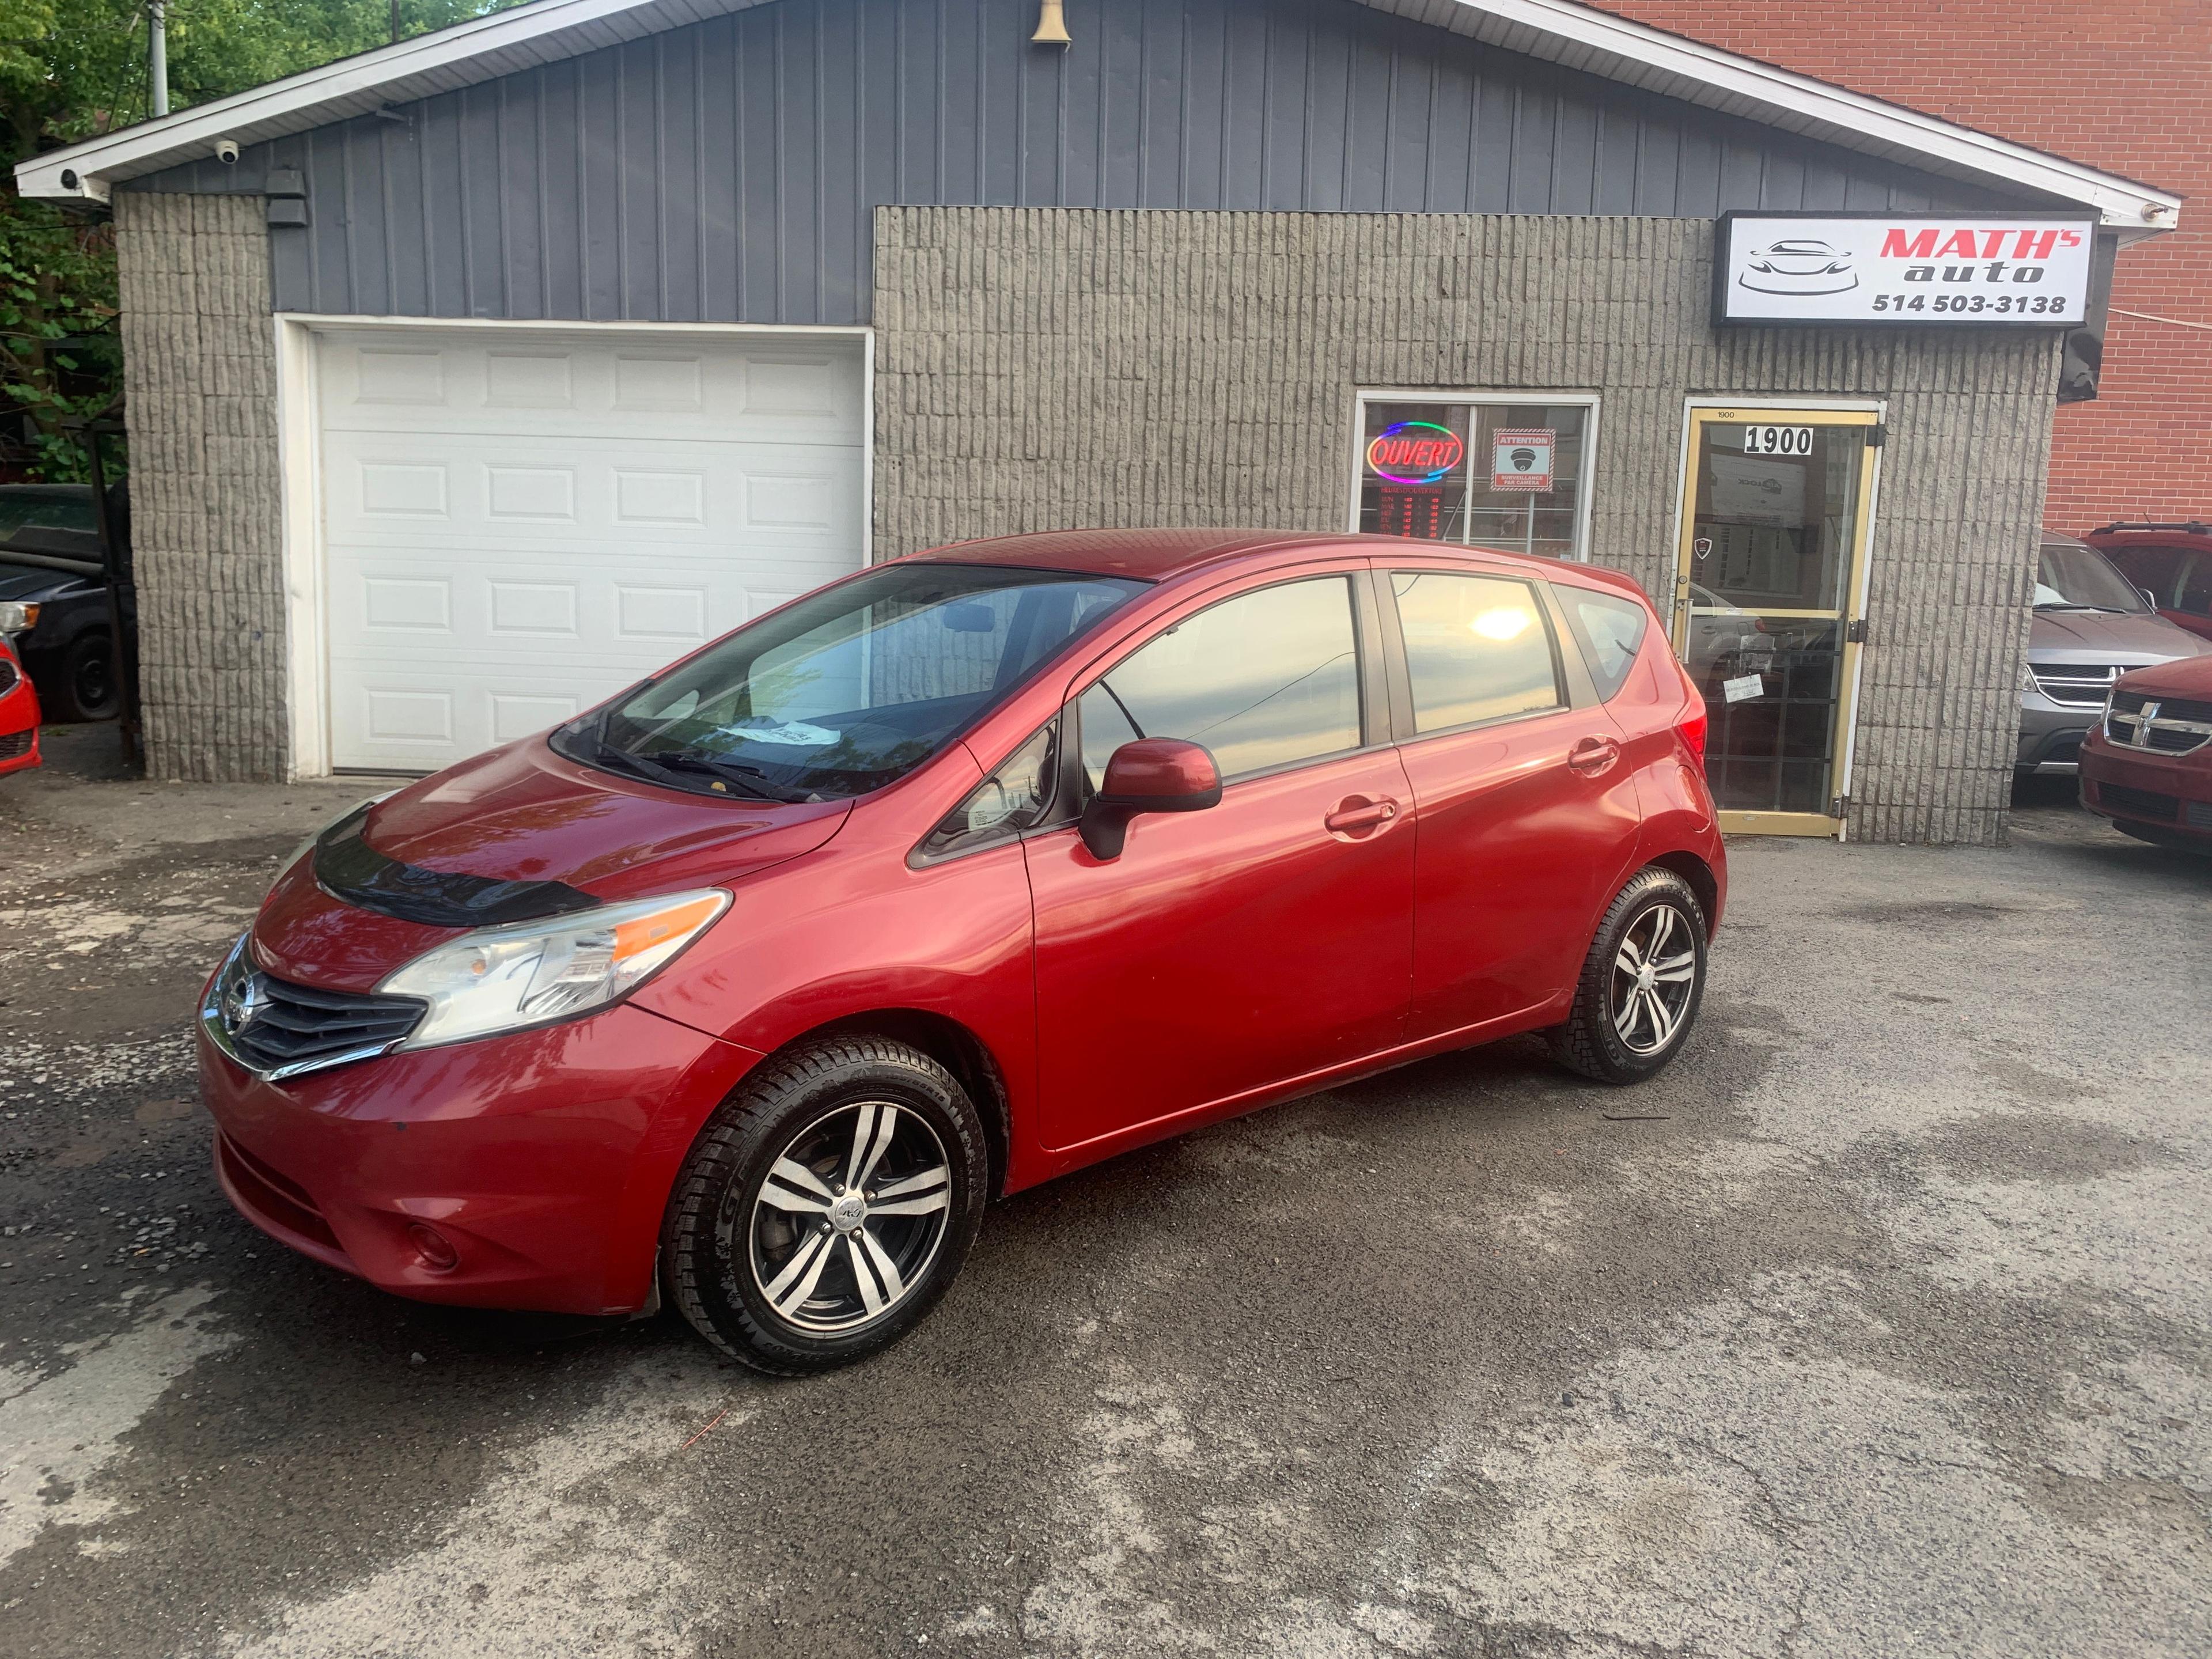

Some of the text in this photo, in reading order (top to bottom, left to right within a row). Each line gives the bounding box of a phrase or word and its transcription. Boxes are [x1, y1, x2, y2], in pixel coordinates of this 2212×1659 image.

[1903, 261, 2044, 283] auto
[1872, 294, 2066, 313] 514 503-3138
[1746, 427, 1810, 454] 1900
[1373, 440, 1457, 467] OUVERT
